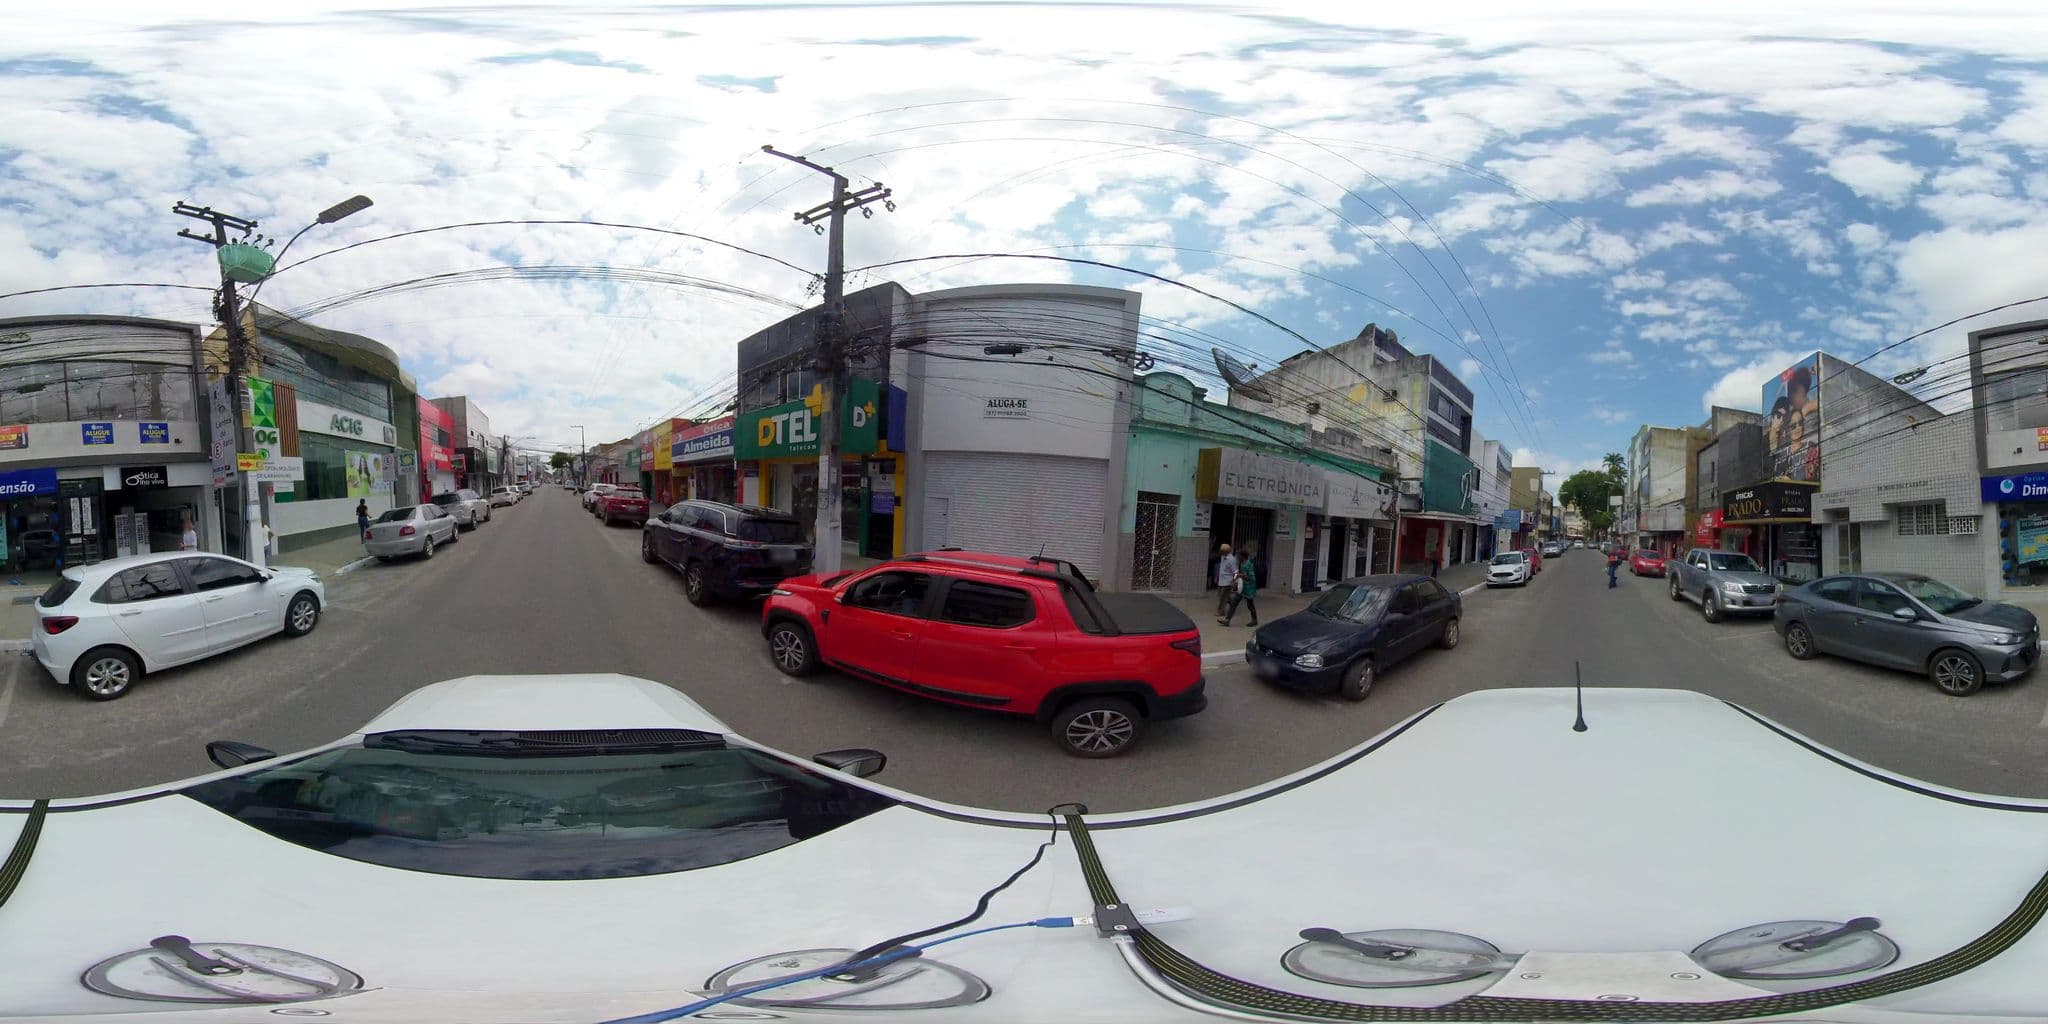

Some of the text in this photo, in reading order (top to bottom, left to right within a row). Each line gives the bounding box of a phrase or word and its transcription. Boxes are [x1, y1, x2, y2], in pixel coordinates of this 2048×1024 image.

[987, 399, 1027, 408] ALUGA-SE
[330, 414, 363, 435] ACIG
[684, 436, 730, 454] Almeida
[1226, 471, 1319, 497] ELETRÔNICA
[1736, 490, 1754, 501] ÓTICAS
[1728, 498, 1762, 517] PRADO
